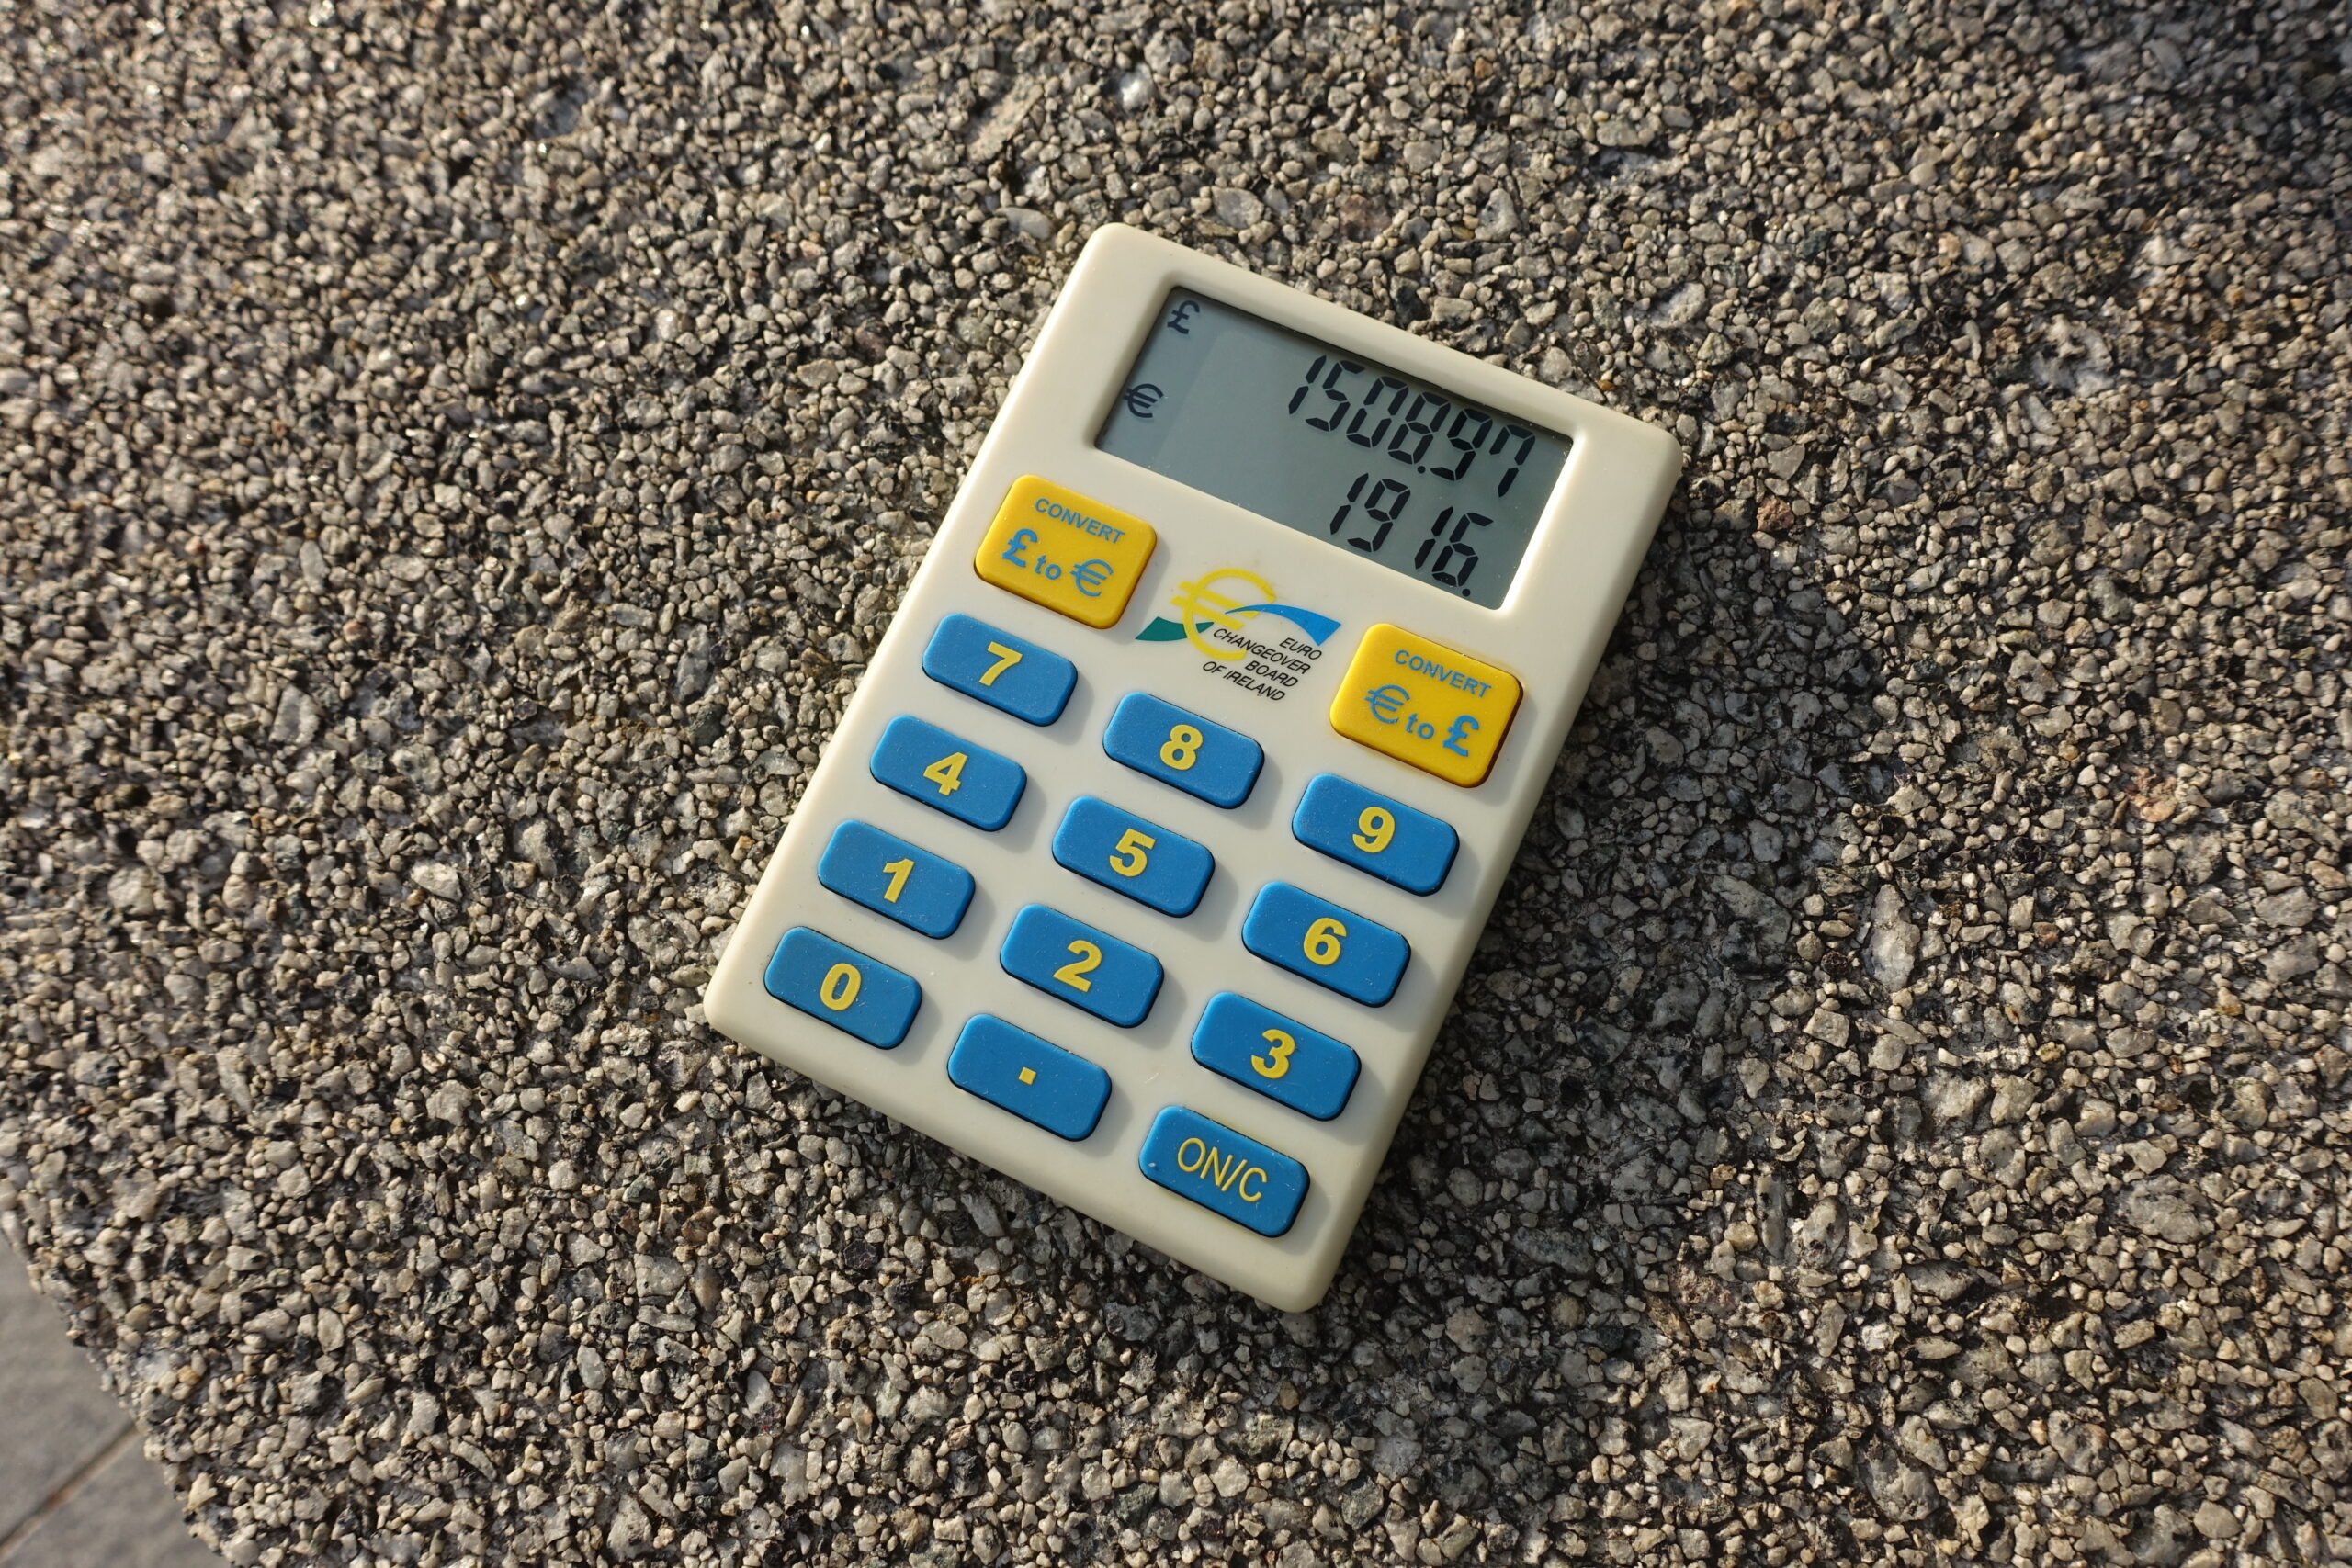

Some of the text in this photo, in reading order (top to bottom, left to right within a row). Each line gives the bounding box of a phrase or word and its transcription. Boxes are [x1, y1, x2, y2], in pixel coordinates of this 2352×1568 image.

[1289, 355, 1536, 498] 1508.97
[1035, 497, 1125, 544] CONVERT
[1002, 528, 1038, 568] £
[1035, 553, 1062, 581] to
[979, 641, 1023, 688] 7
[1213, 627, 1312, 675] CHANGEOVER
[1279, 637, 1323, 661] EURO
[1202, 660, 1285, 703] OF IRELAND
[1245, 660, 1299, 688] BOARD
[1395, 649, 1492, 698] CONVERT
[1159, 724, 1204, 771] 8
[1406, 712, 1435, 740] to
[1442, 715, 1480, 758] £
[922, 751, 967, 796] 4
[1109, 828, 1156, 878] 5
[1351, 806, 1396, 853] 9
[883, 858, 915, 904] 1
[1303, 917, 1347, 966] 6
[820, 963, 861, 1011] 0
[1054, 940, 1102, 993] 2
[1251, 1029, 1296, 1079] 3
[1177, 1137, 1268, 1204] ON/C
